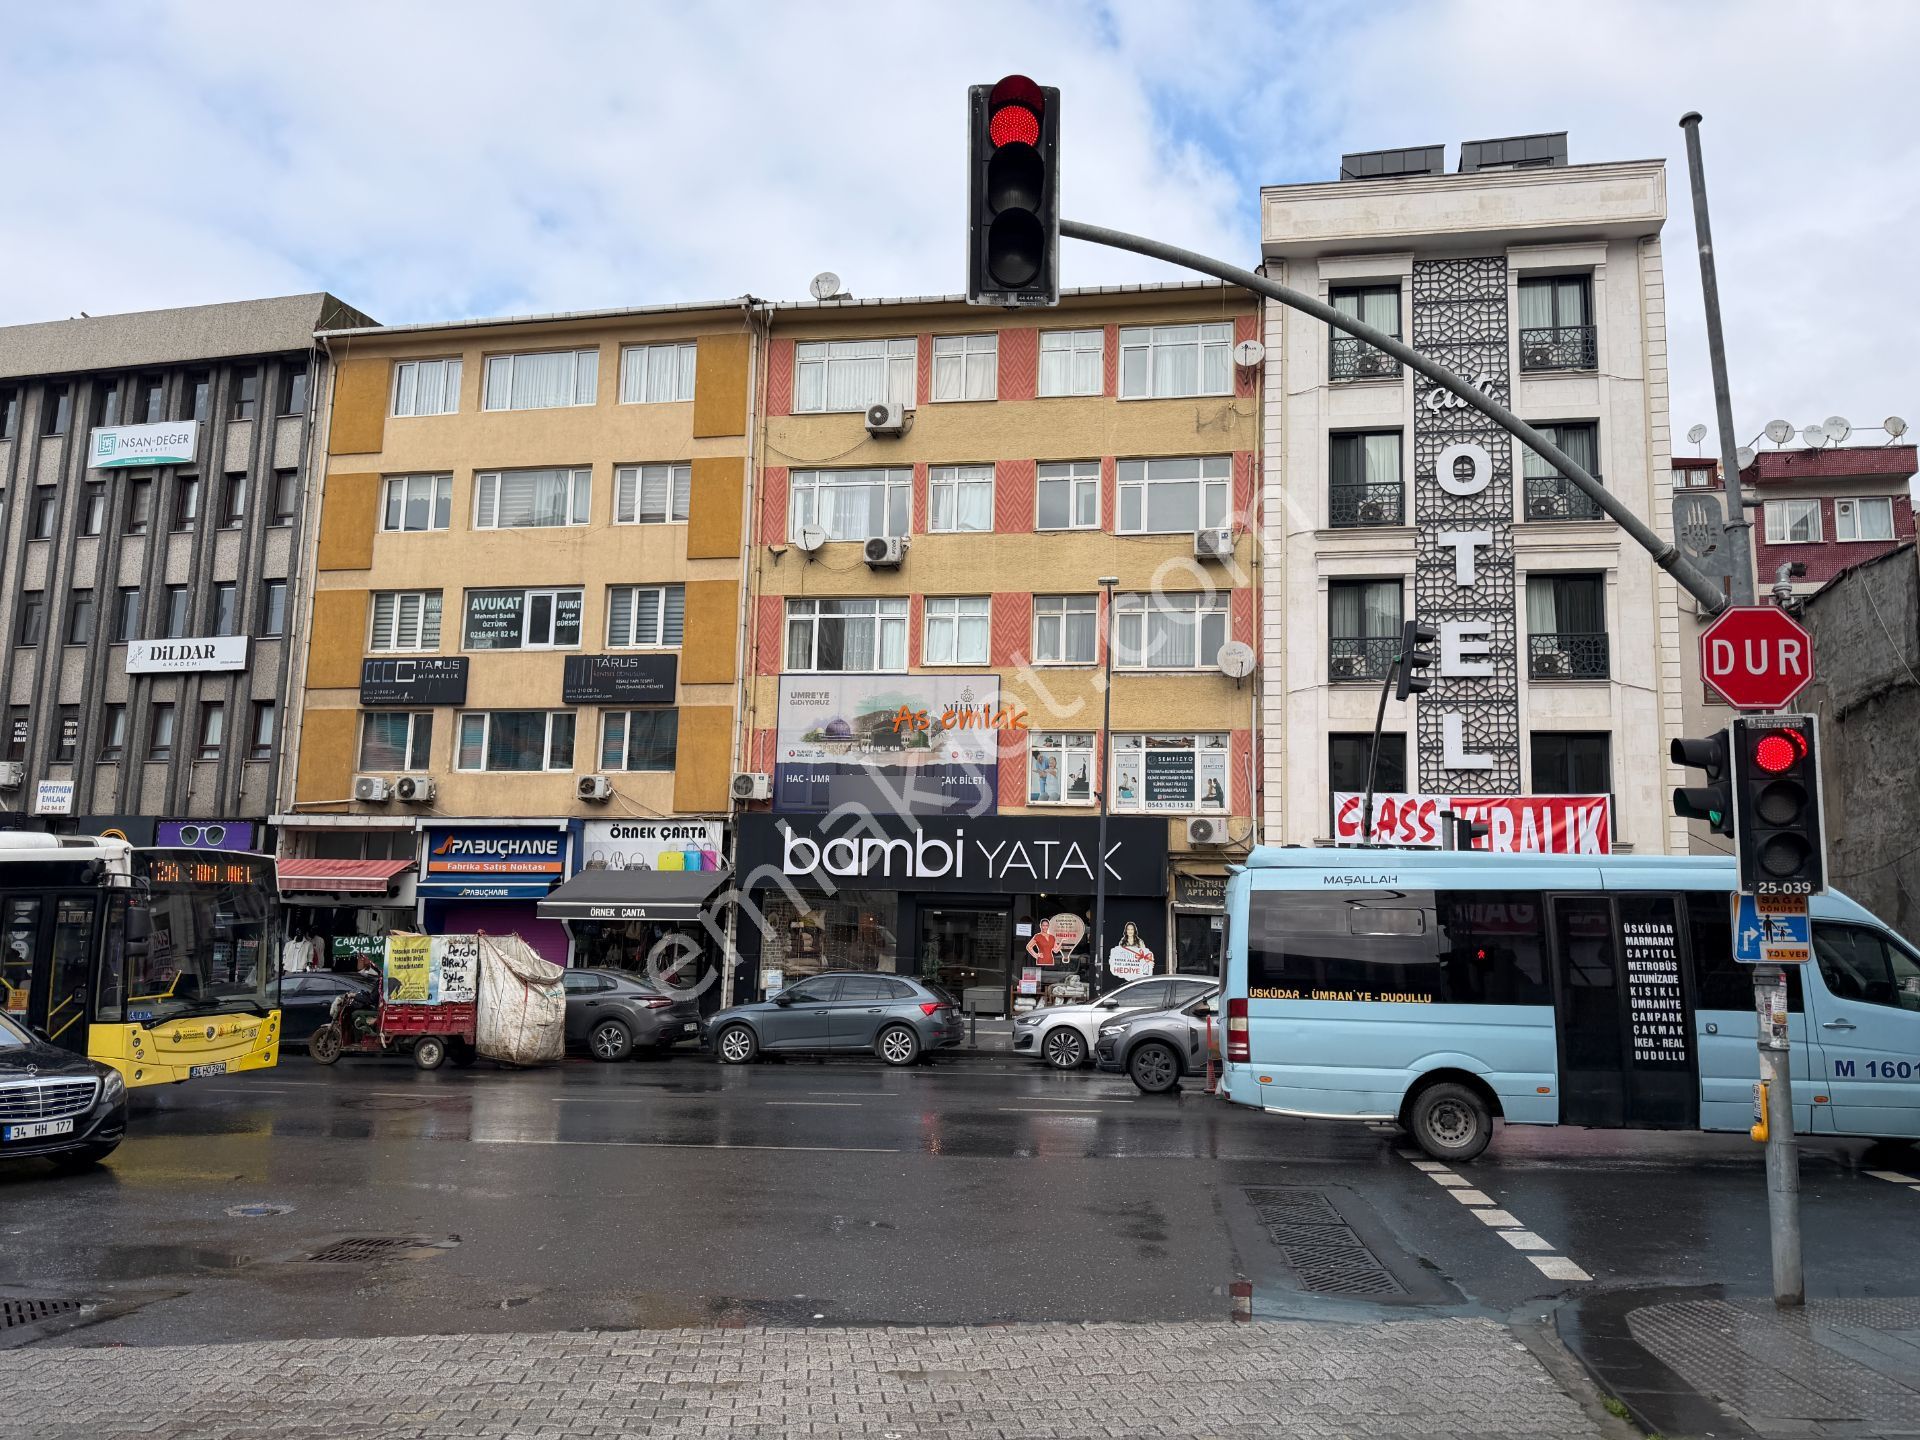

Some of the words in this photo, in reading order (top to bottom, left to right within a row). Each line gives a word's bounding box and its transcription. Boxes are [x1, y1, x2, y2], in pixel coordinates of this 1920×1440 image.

[118, 437, 152, 449] İNSAN
[156, 433, 189, 446] DEĞER
[471, 597, 522, 610] AVUKAT
[558, 600, 580, 609] AVUKAT
[1435, 443, 1494, 769] OTEL
[557, 619, 580, 627] GÜRSOY
[1712, 639, 1802, 675] DUR
[419, 660, 460, 670] TARUS
[595, 658, 638, 668] TARUS
[790, 691, 830, 699] UMRE'YE
[786, 774, 804, 784] HAC
[959, 773, 986, 786] BİLETİ
[40, 783, 72, 794] ÖĞRETMEN
[1338, 796, 1436, 843] CASS
[610, 823, 656, 839] ÖRNEK
[660, 826, 707, 841] ÇANTA
[451, 839, 558, 859] PABUÇHANE
[783, 826, 963, 878] bambi
[976, 840, 1123, 881] YATAK
[447, 863, 480, 871] Fabrika
[483, 863, 507, 872] Satış
[510, 863, 546, 871] Noktası
[1323, 874, 1398, 887] MAŞALLAH
[465, 889, 508, 897] PABUÇHANE
[1187, 888, 1205, 896] APT.
[1758, 882, 1811, 894] 25-039
[1761, 896, 1803, 905] SAĞA
[590, 907, 616, 917] ÖRNEK
[621, 908, 646, 918] ÇANTA
[1760, 905, 1804, 913] DÖNÜŞTE
[1623, 922, 1673, 934] ÜSKÜDAR
[335, 936, 370, 947] CANIM
[1625, 936, 1674, 946] MARMARAY
[1626, 949, 1676, 959] CAPITOL
[1767, 950, 1787, 958] YOL
[1113, 966, 1141, 975] HEDİYE
[1628, 960, 1678, 971] METROBÜS
[1629, 973, 1679, 984] ALTUNİZADE
[1250, 986, 1300, 999] ÜSKÜDAR
[1380, 992, 1432, 1003] DUDULLU
[1630, 986, 1680, 997] KISIKLI
[1631, 998, 1681, 1009] ÜMRANİYE
[1632, 1012, 1682, 1022] CANPARK
[1633, 1025, 1684, 1036] ÇAKMAK
[1634, 1036, 1655, 1048] İKEA
[1662, 1038, 1685, 1048] REAL
[1635, 1050, 1685, 1061] DUDULLU
[1834, 1060, 1856, 1078] M
[13, 1126, 27, 1138] 34
[34, 1124, 48, 1135] HH
[56, 1120, 72, 1132] 177
